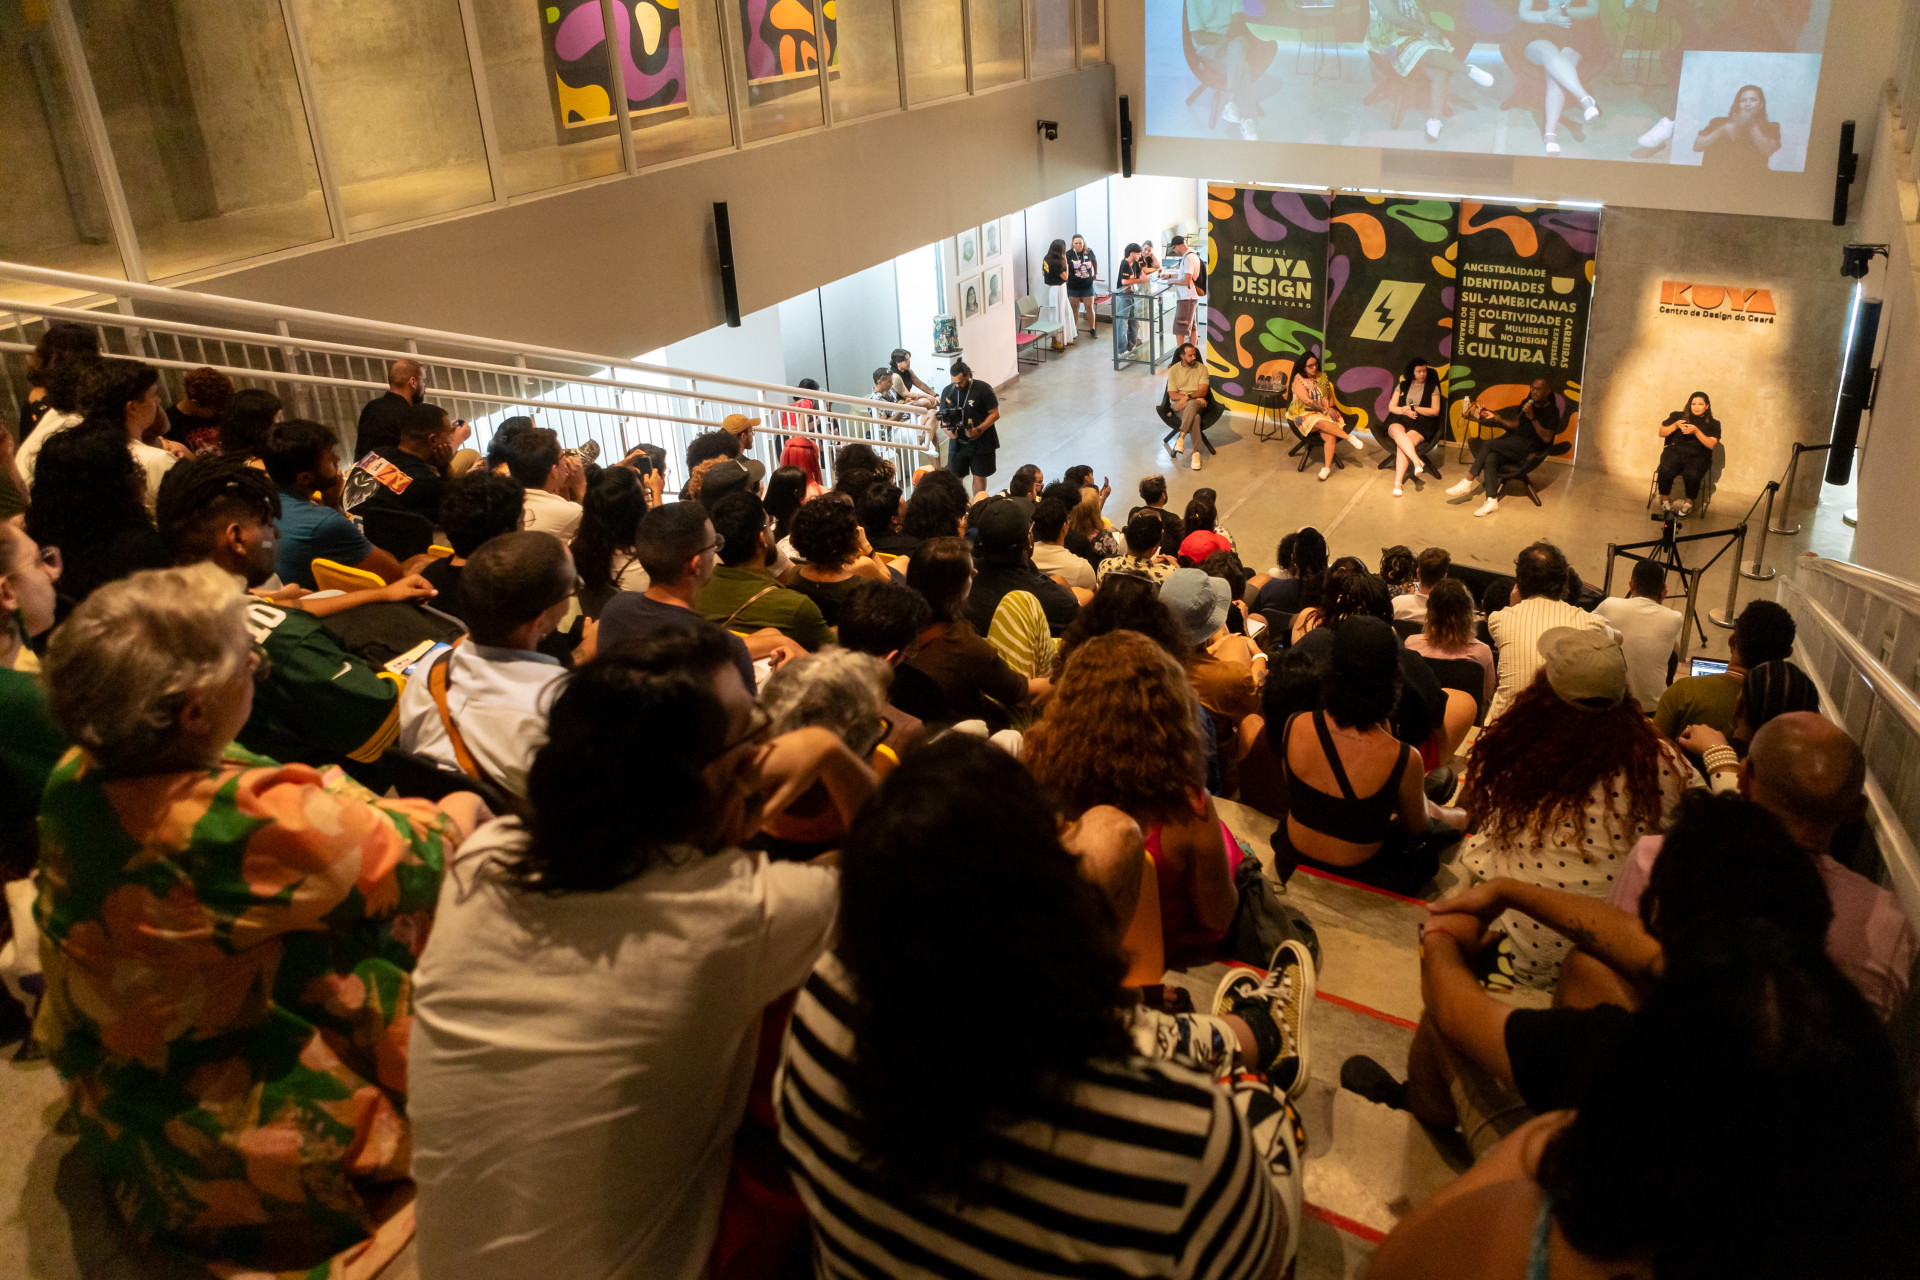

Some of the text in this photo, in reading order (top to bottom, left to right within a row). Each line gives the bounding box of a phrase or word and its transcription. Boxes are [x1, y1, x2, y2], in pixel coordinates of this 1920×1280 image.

[1234, 245, 1286, 256] FESTIVAL
[1233, 253, 1312, 279] KUYA
[1463, 262, 1547, 278] ANCESTRALIDADE
[1232, 275, 1312, 300] DESIGN
[1462, 276, 1545, 294] IDENTIDADES
[1232, 295, 1312, 309] SULAMERICANO
[1461, 291, 1577, 313] SUL-AMERICANAS
[1659, 280, 1777, 315] KUYA
[1468, 307, 1476, 335] FUTURO
[1478, 308, 1562, 327] COLETIVIDADE
[1659, 306, 1775, 324] Centro de Design do Ceará
[1457, 306, 1468, 356] DO TRABALHO
[1500, 333, 1548, 346] NO DESIGN
[1504, 323, 1549, 336] MULHERES
[1466, 342, 1546, 365] CULTURA
[1549, 327, 1560, 367] EXPRESSÃO
[1560, 317, 1573, 369] CARREIRAS
